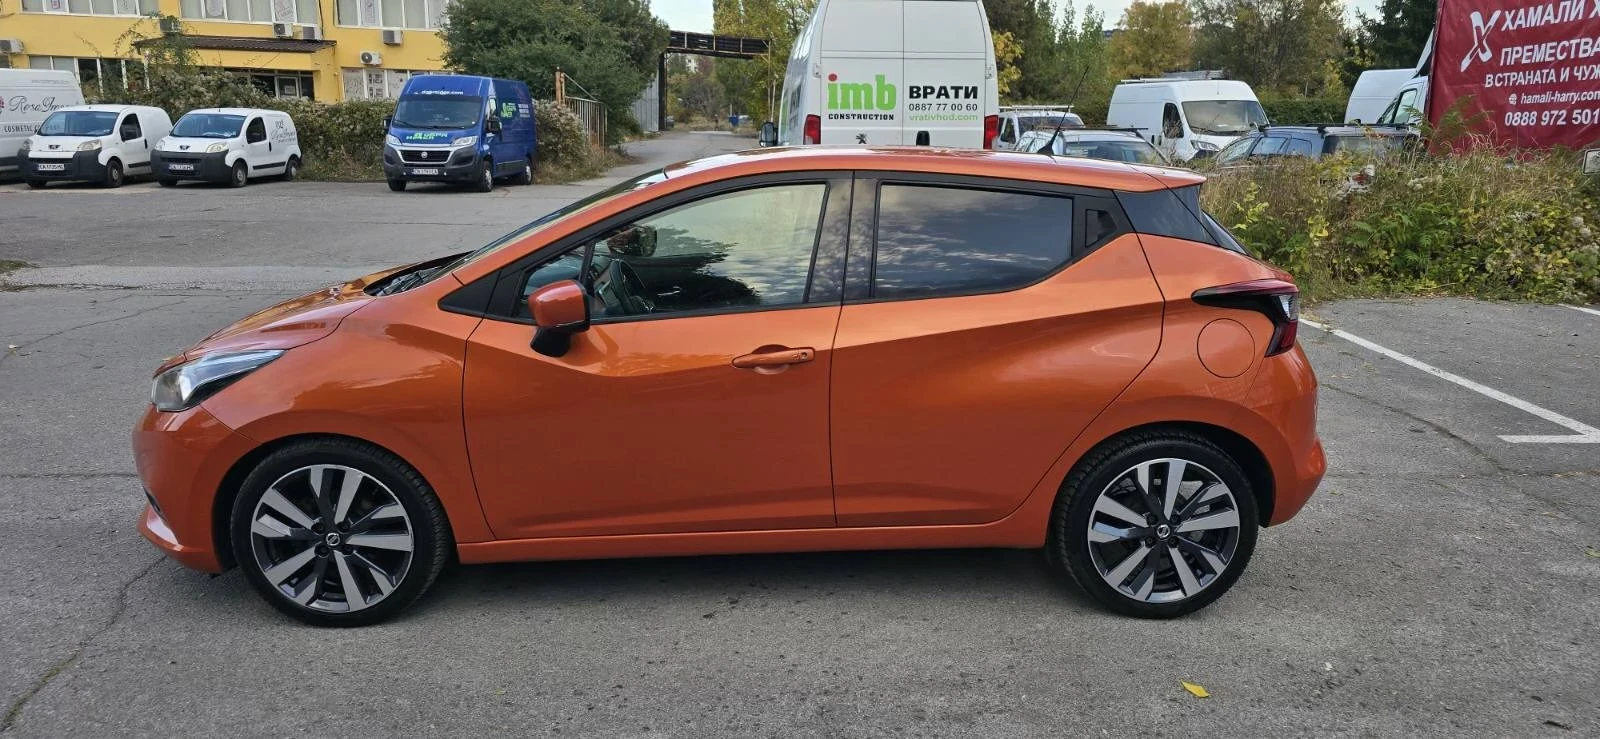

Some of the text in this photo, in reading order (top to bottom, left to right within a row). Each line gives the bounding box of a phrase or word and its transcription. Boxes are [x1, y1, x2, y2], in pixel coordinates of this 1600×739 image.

[1501, 0, 1585, 31] ХАМАЛИ
[1500, 38, 1600, 66] ПРЕМЕСТВА
[1560, 67, 1570, 82] И
[828, 73, 896, 110] imb
[909, 86, 978, 99] ВРАТИ
[909, 113, 978, 121] vrativhod.com
[1504, 108, 1600, 126] 0888 972 501
[4, 124, 33, 133] COSMETIC
